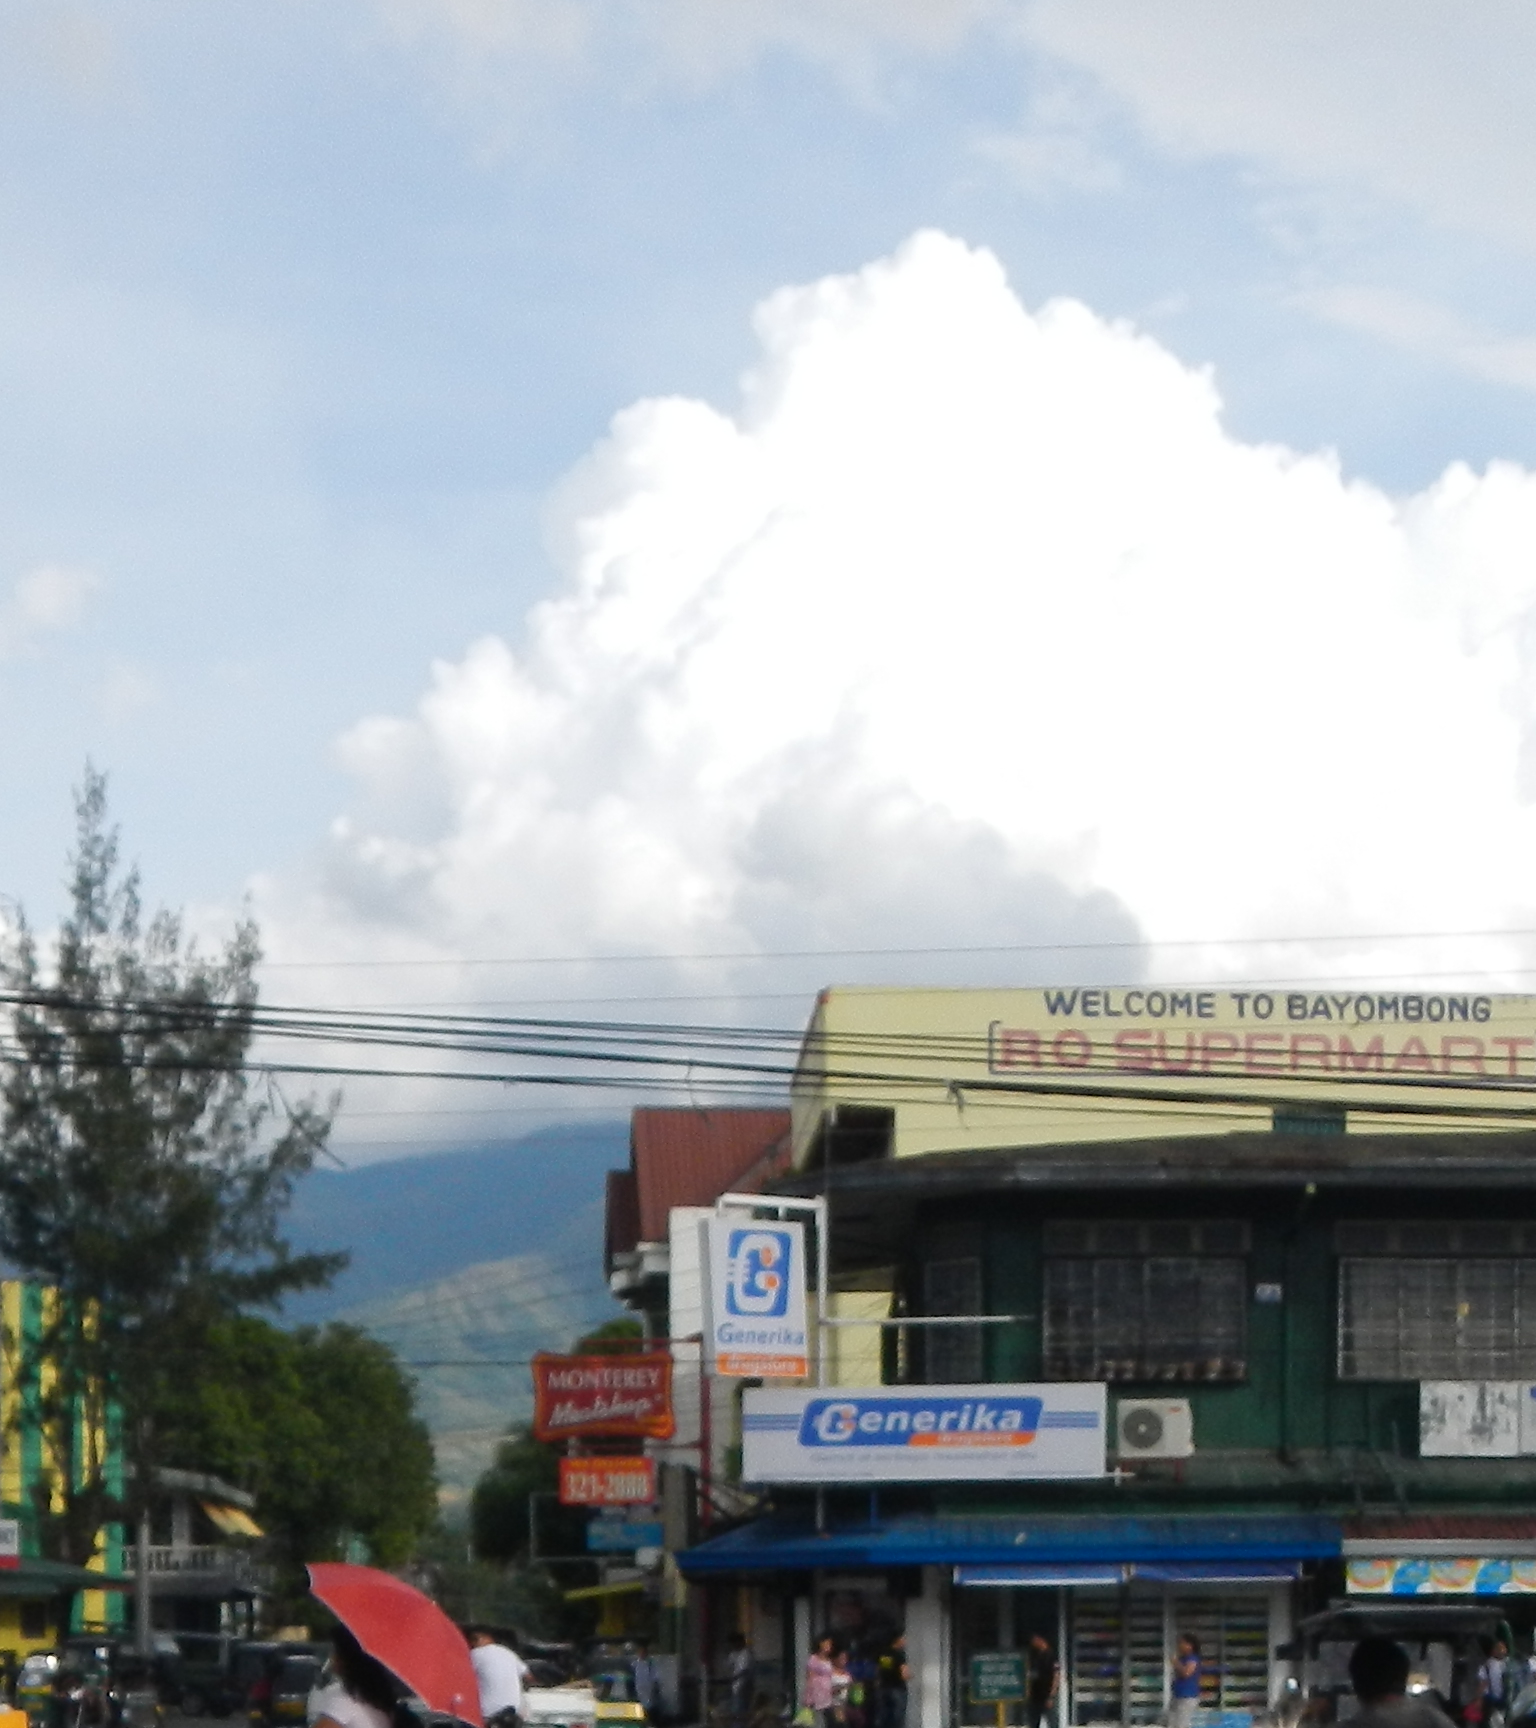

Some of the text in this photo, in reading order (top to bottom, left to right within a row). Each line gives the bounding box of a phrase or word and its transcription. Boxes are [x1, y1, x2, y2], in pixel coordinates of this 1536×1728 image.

[1044, 990, 1492, 1023] WELCOME TO BAYOMBONG
[1112, 1029, 1535, 1078] SUPERMART
[717, 1322, 805, 1345] Generika
[548, 1369, 659, 1389] MONTEREY
[815, 1403, 1022, 1441] Generika
